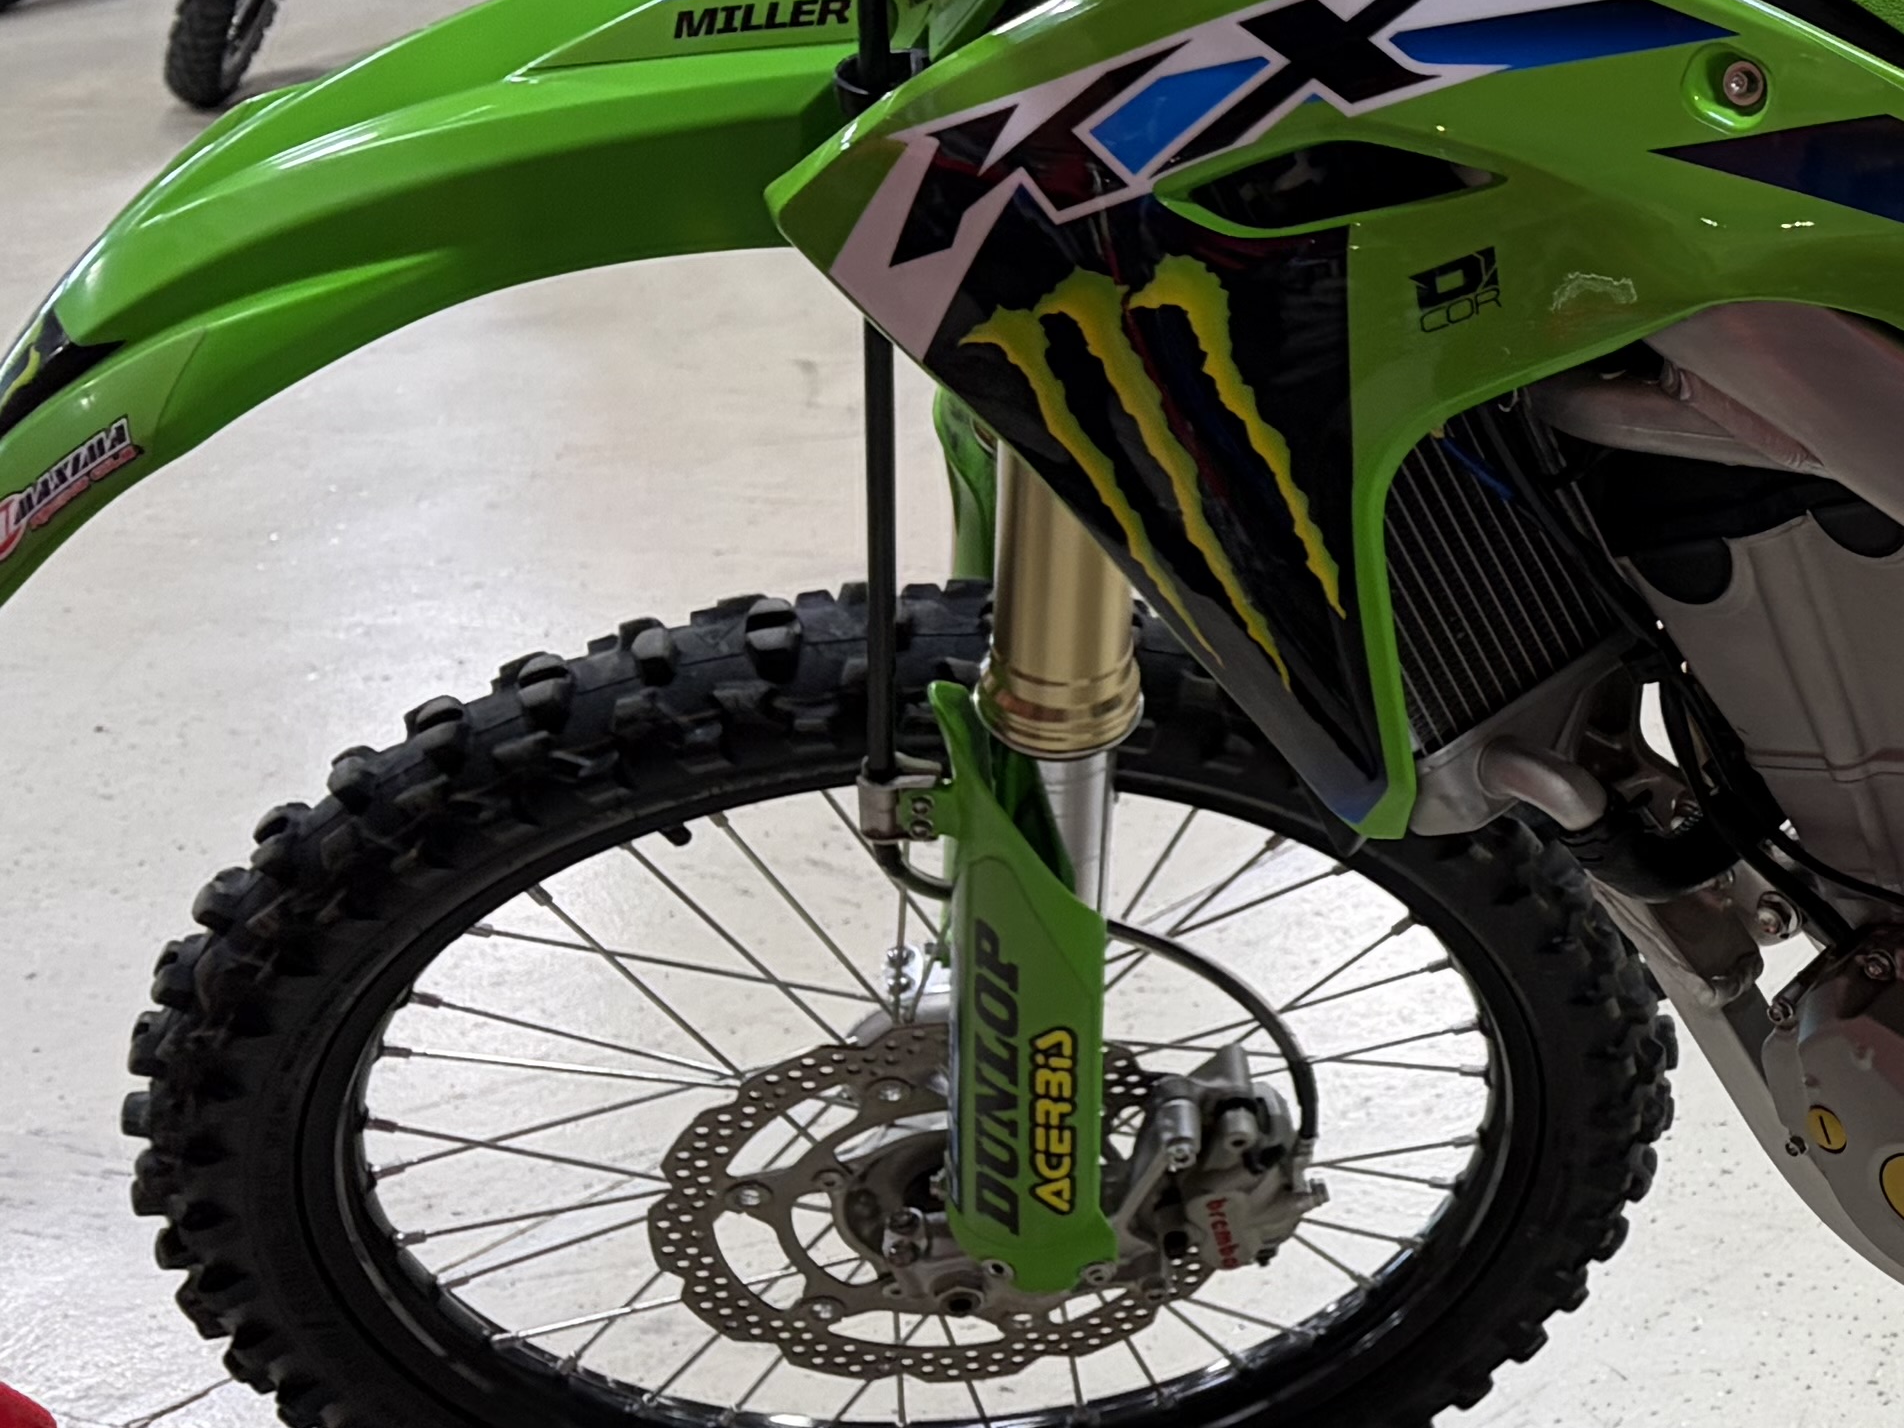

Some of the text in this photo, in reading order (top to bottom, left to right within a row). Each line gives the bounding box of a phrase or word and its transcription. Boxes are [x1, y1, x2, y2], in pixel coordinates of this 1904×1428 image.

[1420, 288, 1502, 333] COR
[973, 917, 1020, 1236] DUNLOP
[1206, 1196, 1239, 1270] brembo
